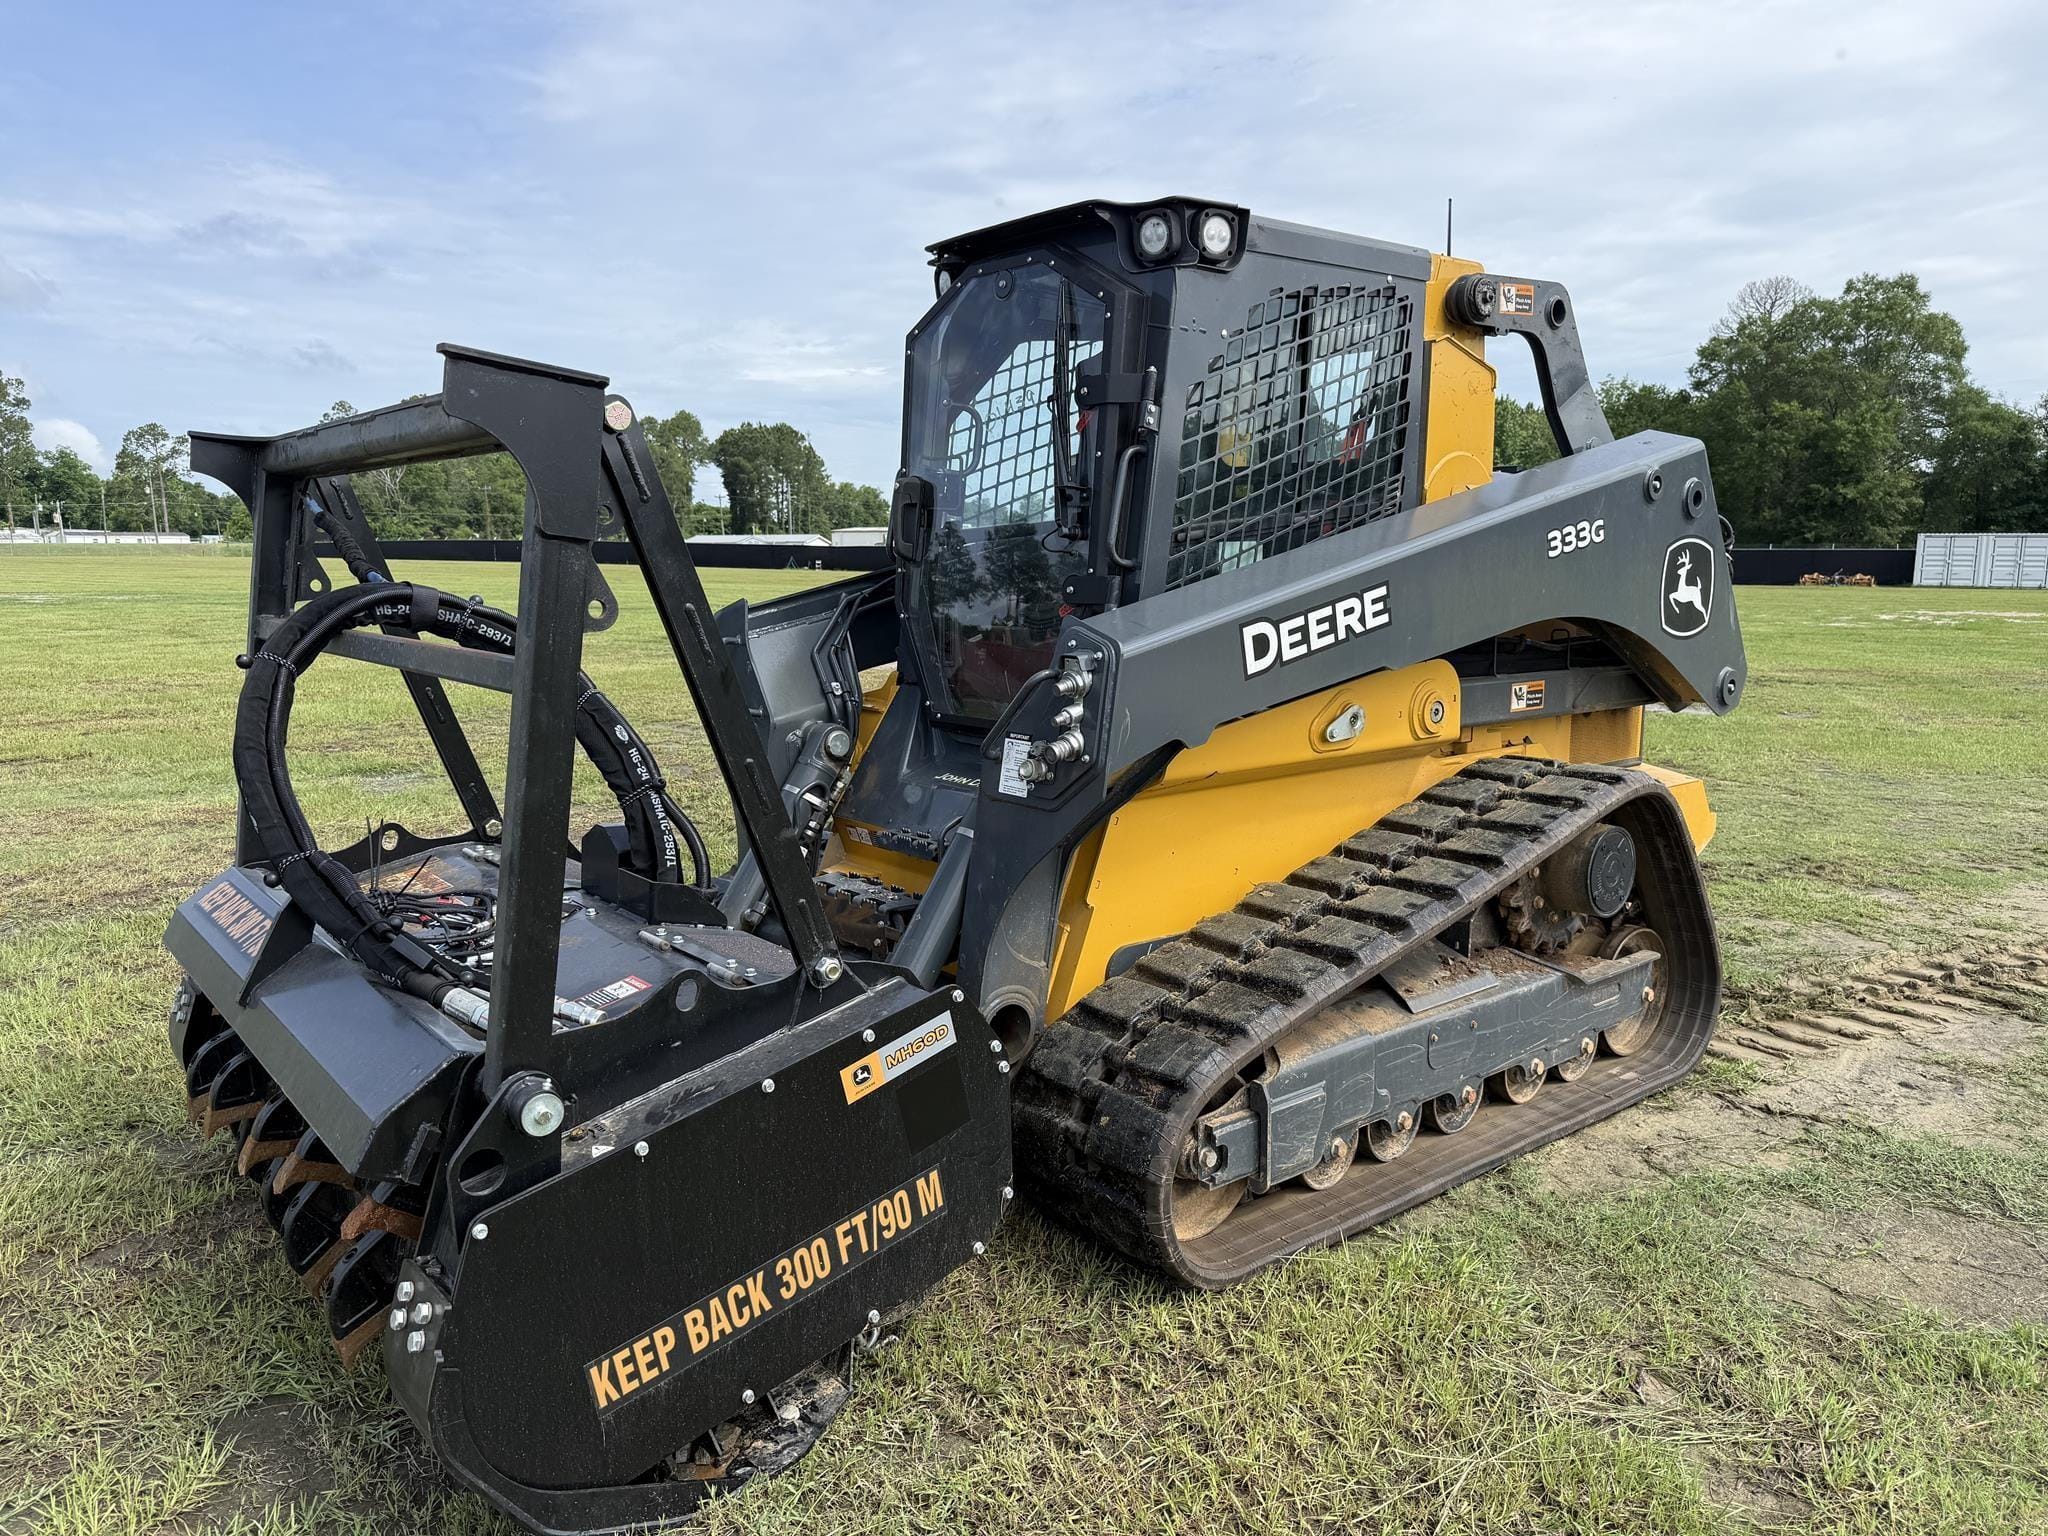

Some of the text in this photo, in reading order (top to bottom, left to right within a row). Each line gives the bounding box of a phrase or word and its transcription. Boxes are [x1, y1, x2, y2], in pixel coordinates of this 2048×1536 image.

[1547, 519, 1605, 558] 333G
[1242, 585, 1390, 676] DEERE
[628, 747, 651, 781] HG-24
[934, 773, 972, 784] JOHN
[211, 893, 254, 929] BACK
[225, 907, 265, 940] 300
[885, 1024, 949, 1070] MH60D
[590, 1169, 944, 1409] KEEP BACK 300 FT/90 M
